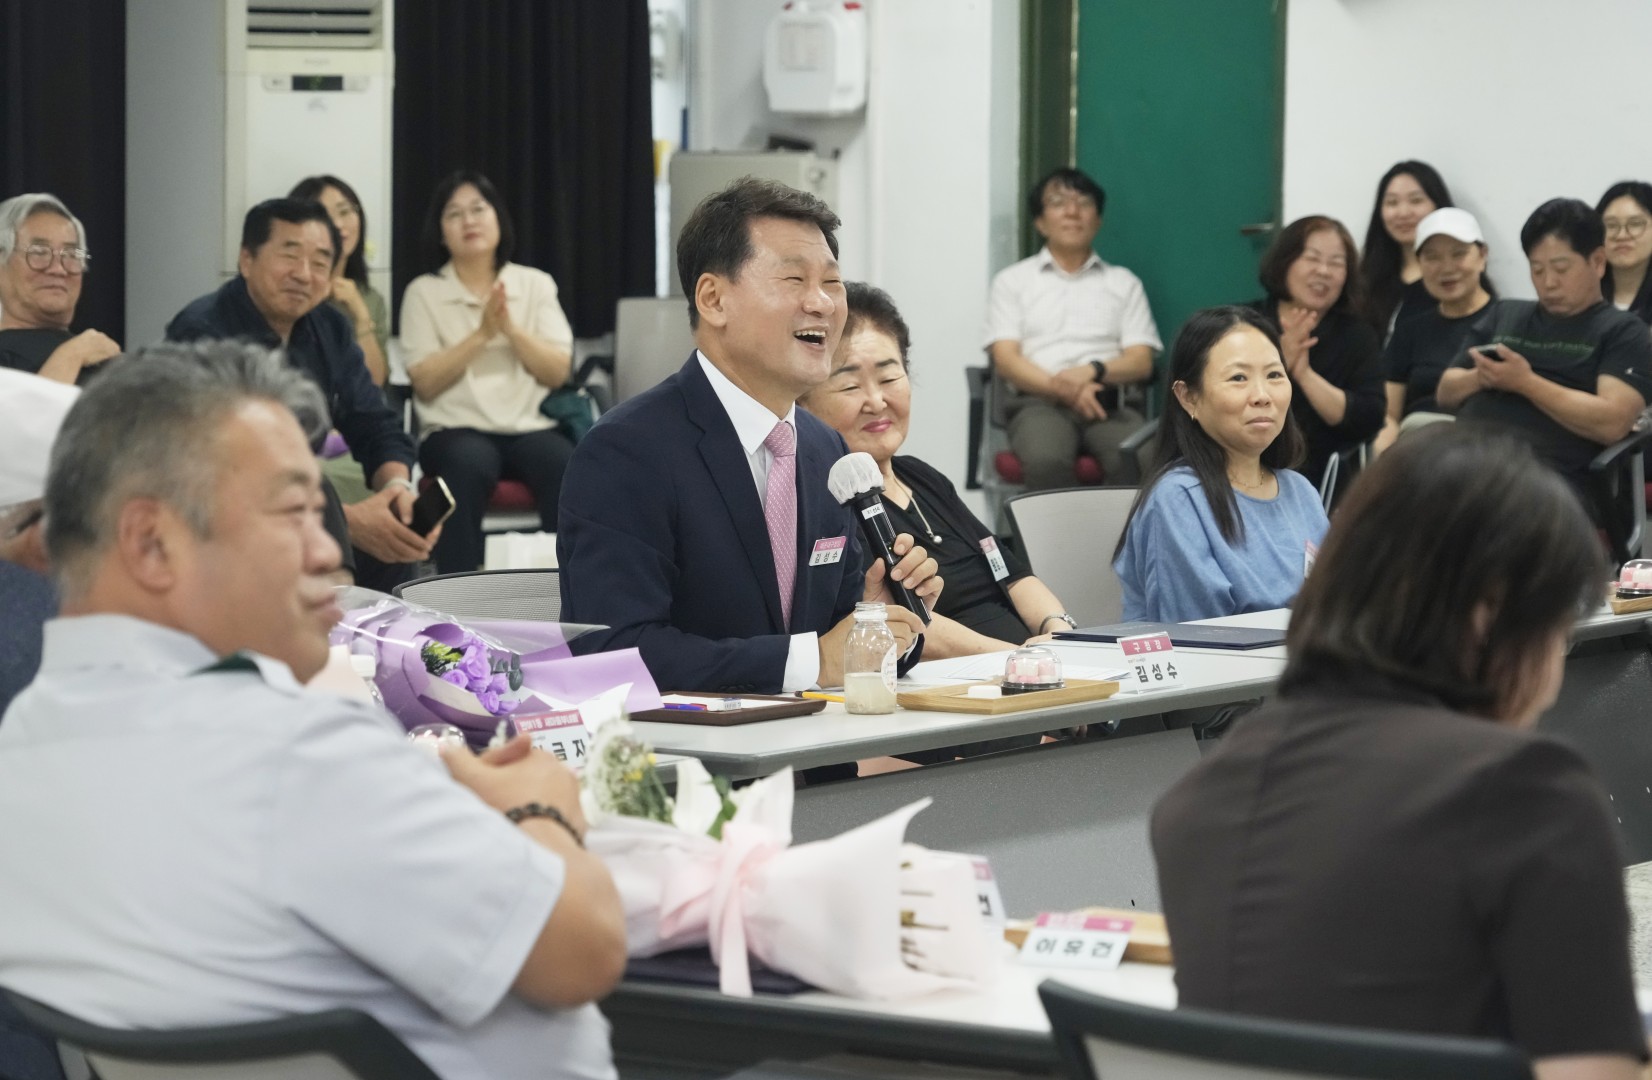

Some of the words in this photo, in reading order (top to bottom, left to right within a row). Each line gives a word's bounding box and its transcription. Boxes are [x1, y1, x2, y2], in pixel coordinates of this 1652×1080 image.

[815, 551, 838, 564] 김성수
[1132, 639, 1162, 653] 구청장
[1135, 661, 1178, 683] 김성수
[531, 738, 587, 761] 금자
